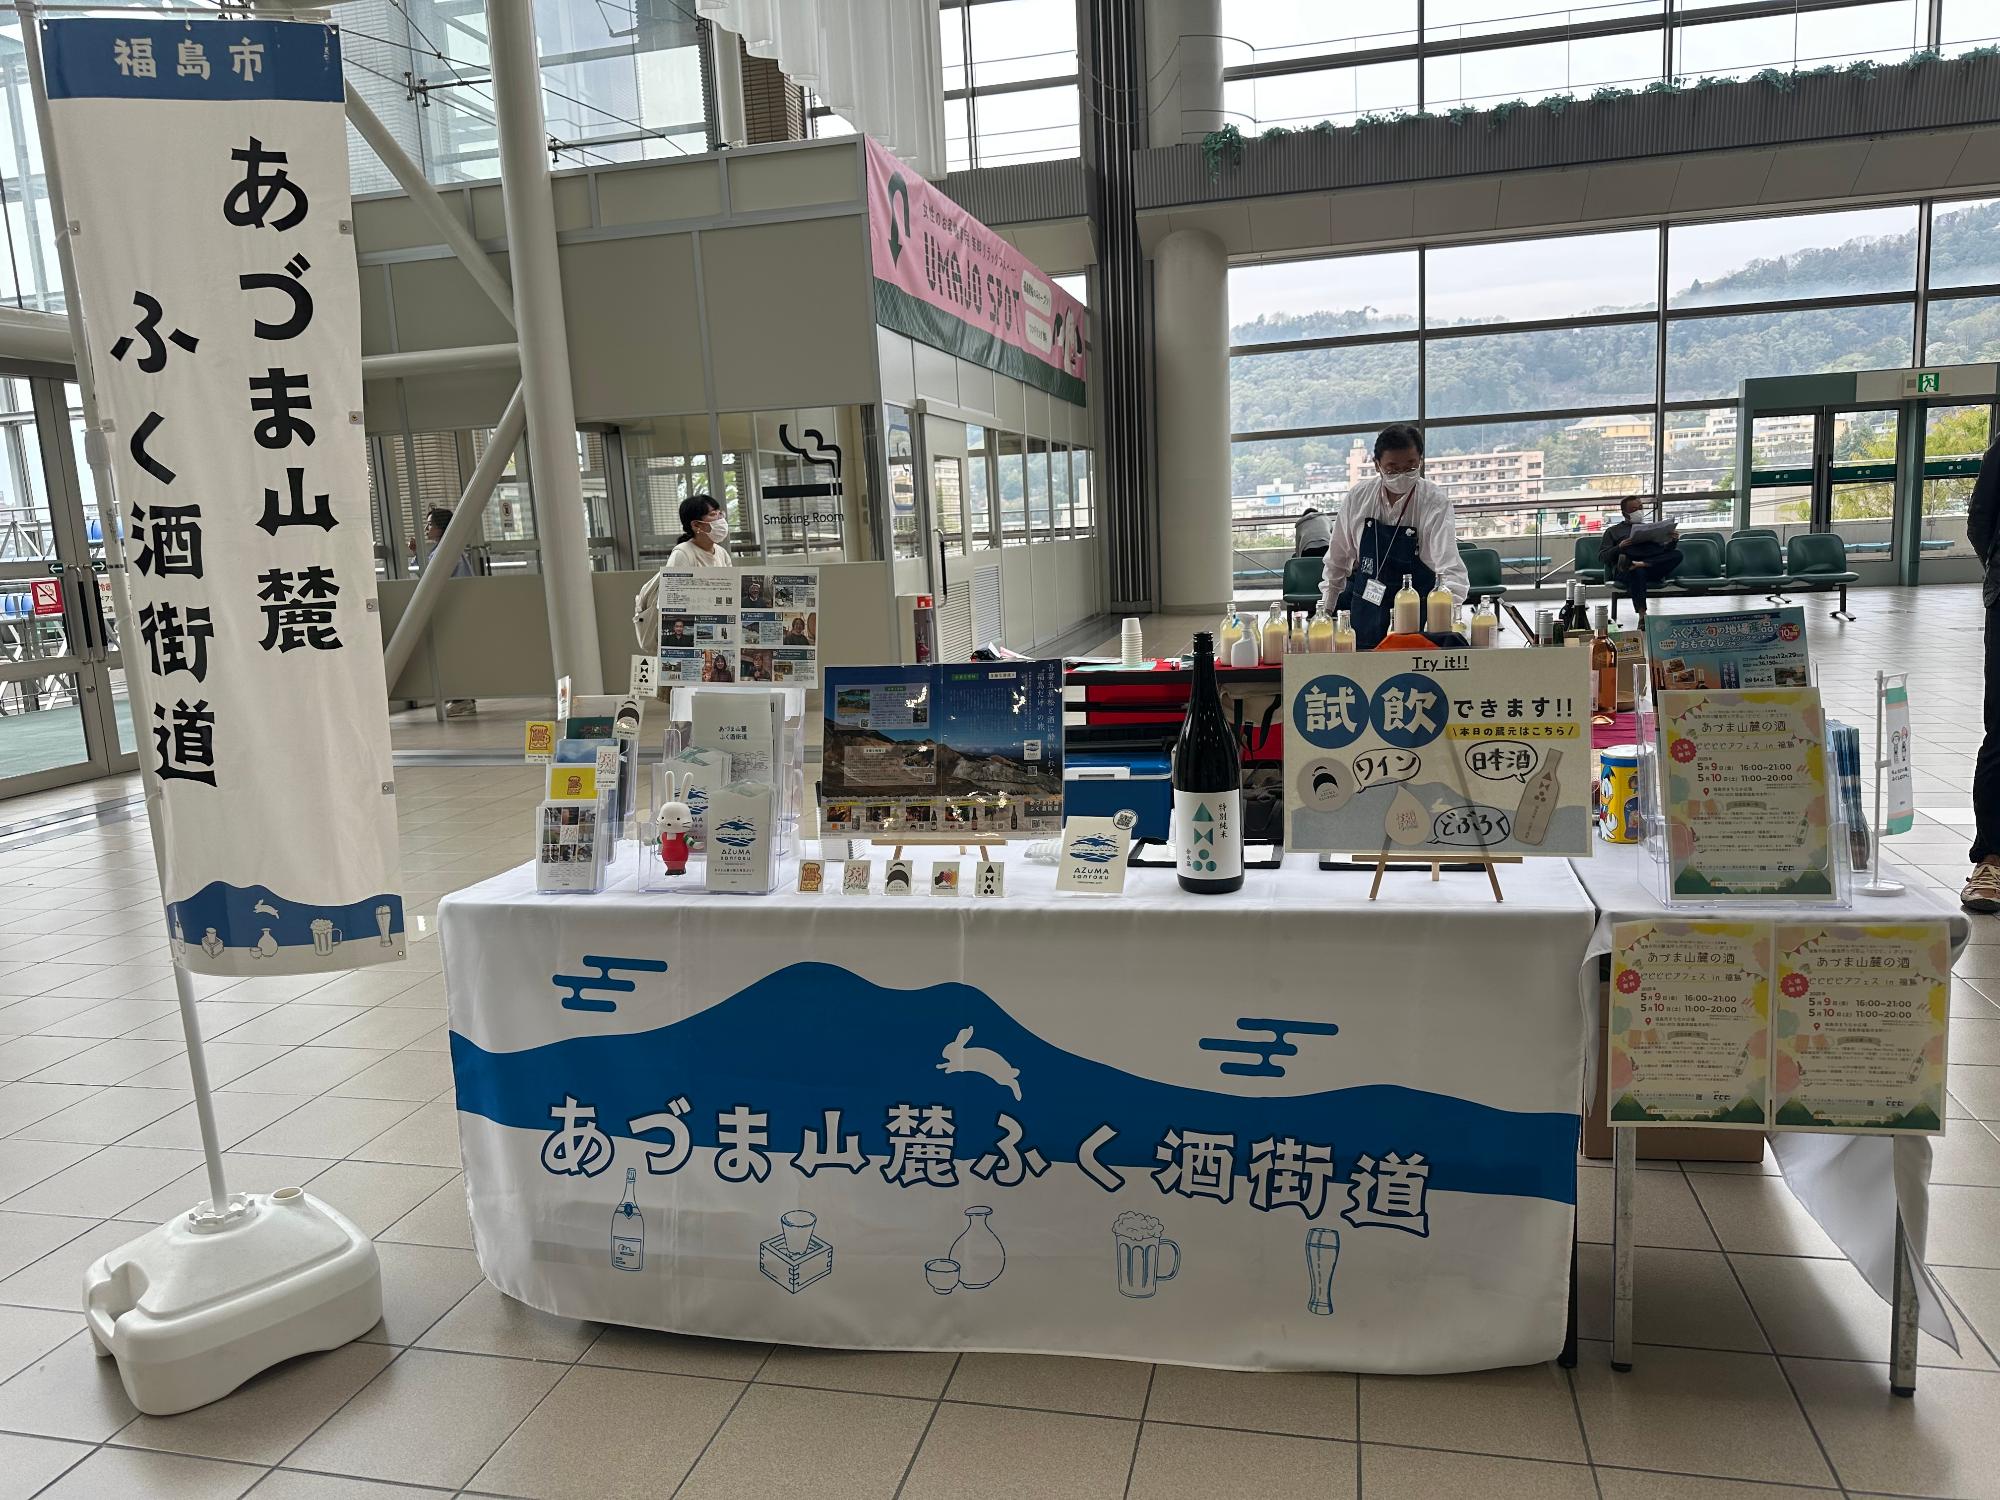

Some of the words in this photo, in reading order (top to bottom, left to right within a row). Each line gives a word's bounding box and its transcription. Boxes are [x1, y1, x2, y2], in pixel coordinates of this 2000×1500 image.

[114, 37, 265, 81] 福島市
[923, 231, 984, 315] UMAJO
[987, 273, 1020, 336] SPOT
[223, 136, 343, 653] あづま山麓
[764, 513, 810, 526] Smoking
[812, 511, 844, 524] Room
[110, 290, 217, 788] ふく酒街道
[1413, 655, 1438, 671] Try
[1444, 655, 1470, 669] it!!
[1304, 685, 1439, 735] 試飲
[1453, 696, 1573, 719] できます!!
[718, 725, 748, 733] あづま山麓
[719, 733, 748, 741] ふく酒街道
[1701, 720, 1786, 733] あづま山麓の酒
[1356, 755, 1417, 781] ワイン
[1472, 748, 1531, 772] 日本酒
[1441, 809, 1509, 838] どぶろく
[721, 848, 751, 856] AZUMA
[1647, 951, 1736, 965] あづま山麓の酒
[1816, 956, 1910, 969] あづま山麓の酒
[540, 1093, 1430, 1238] あづま山麓ふく酒街道
